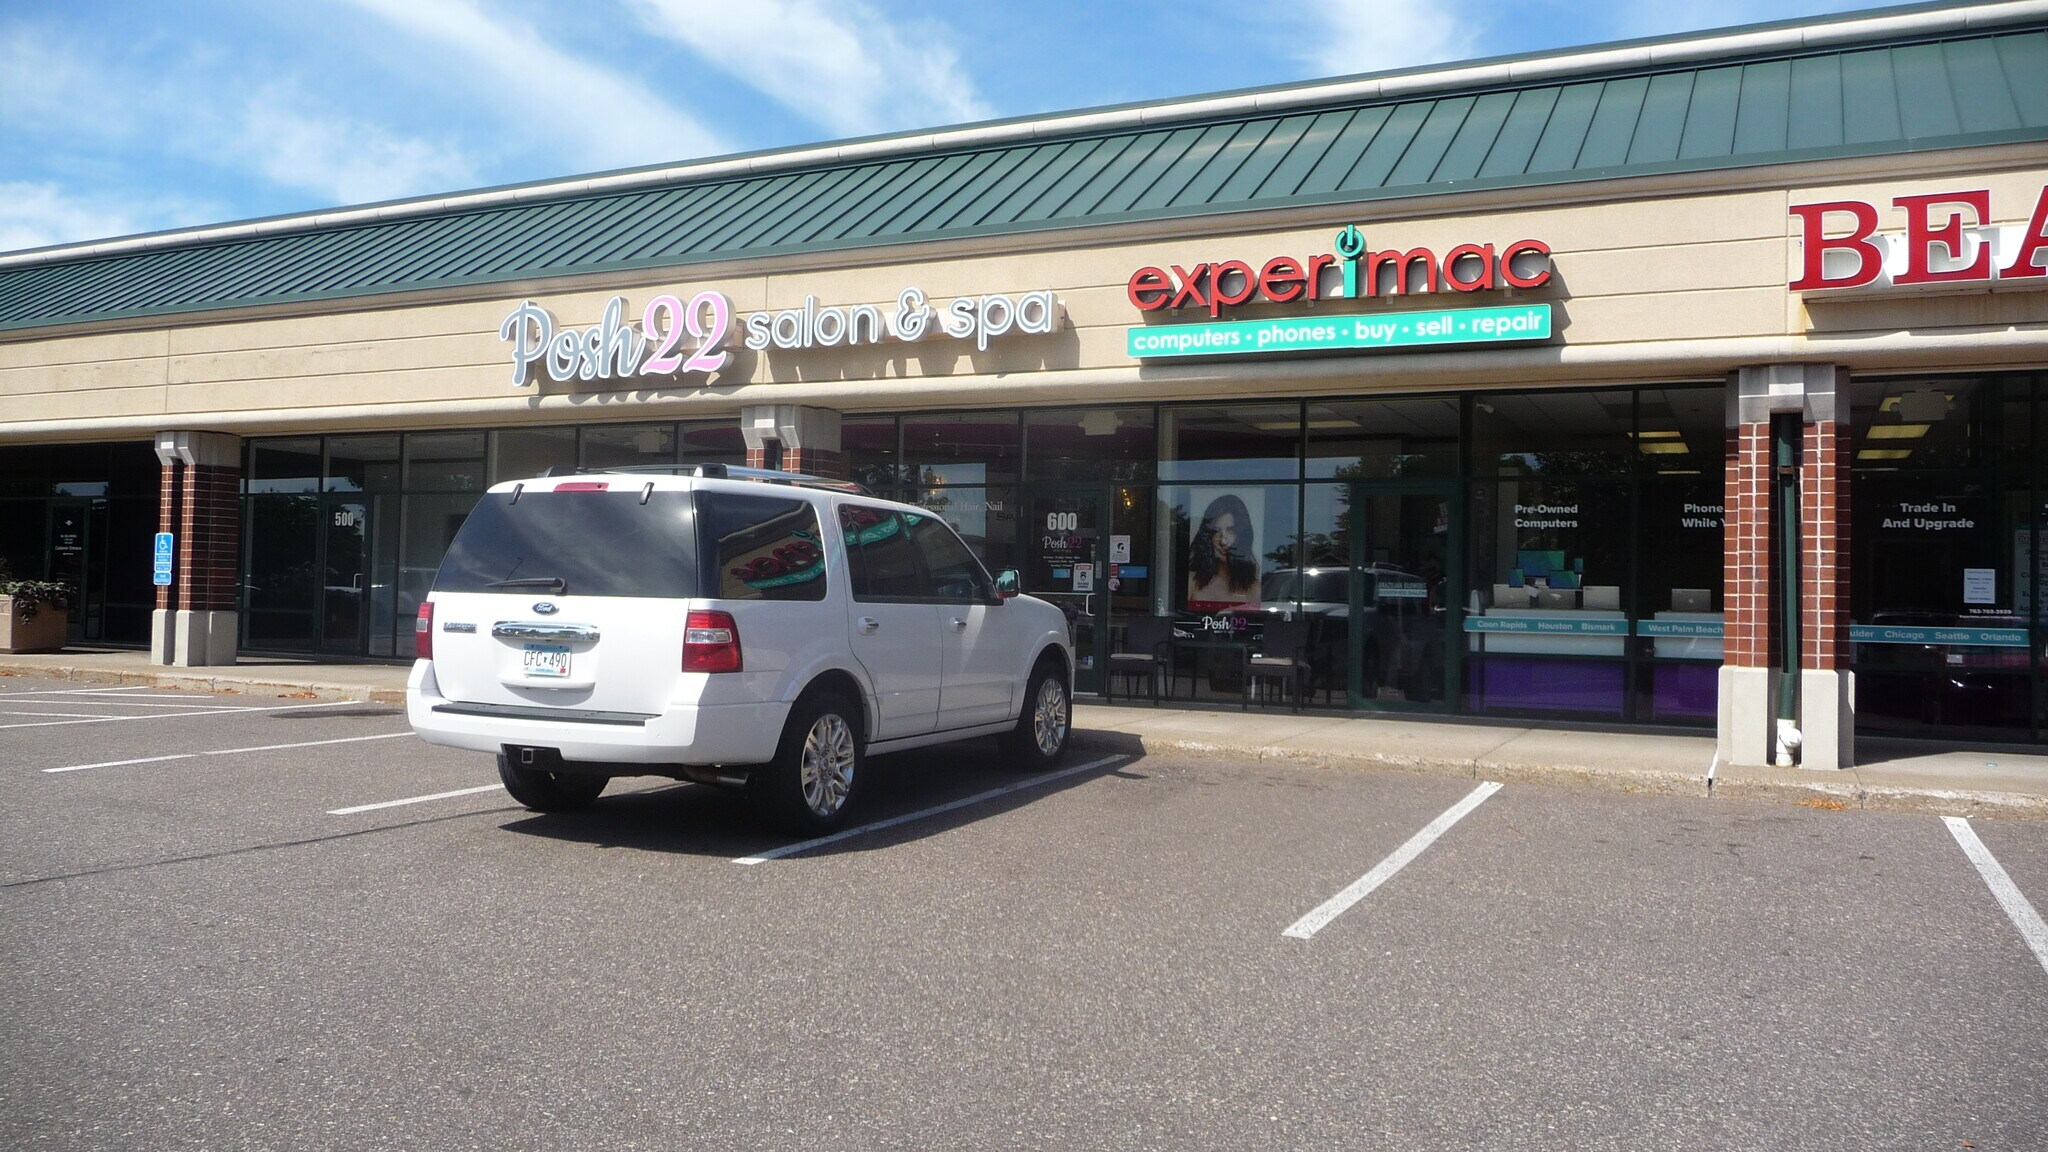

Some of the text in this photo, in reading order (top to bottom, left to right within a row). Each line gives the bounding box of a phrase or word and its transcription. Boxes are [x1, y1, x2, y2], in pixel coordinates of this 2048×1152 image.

[1127, 224, 1552, 318] experimac
[745, 294, 880, 350] salon
[893, 286, 931, 342] &
[947, 289, 1053, 351] spa
[1133, 310, 1542, 352] computers phones buy sell repair
[909, 500, 958, 511] Pofessional
[985, 501, 1003, 511] Nail
[1514, 504, 1578, 514] Pre-Owned
[1683, 503, 1724, 513] Phone
[1900, 502, 1956, 513] Trade In
[335, 512, 354, 526] 500
[1047, 512, 1077, 531] 600
[1514, 518, 1578, 530] Computers
[1681, 517, 1718, 528] While
[1882, 518, 1975, 530] And Upgrade
[1477, 620, 1616, 631] Coon Rapids Houston Bismark
[1648, 624, 1724, 634] West Palm Beach
[1849, 629, 2022, 642] ulder Chicago Seattle Orlando
